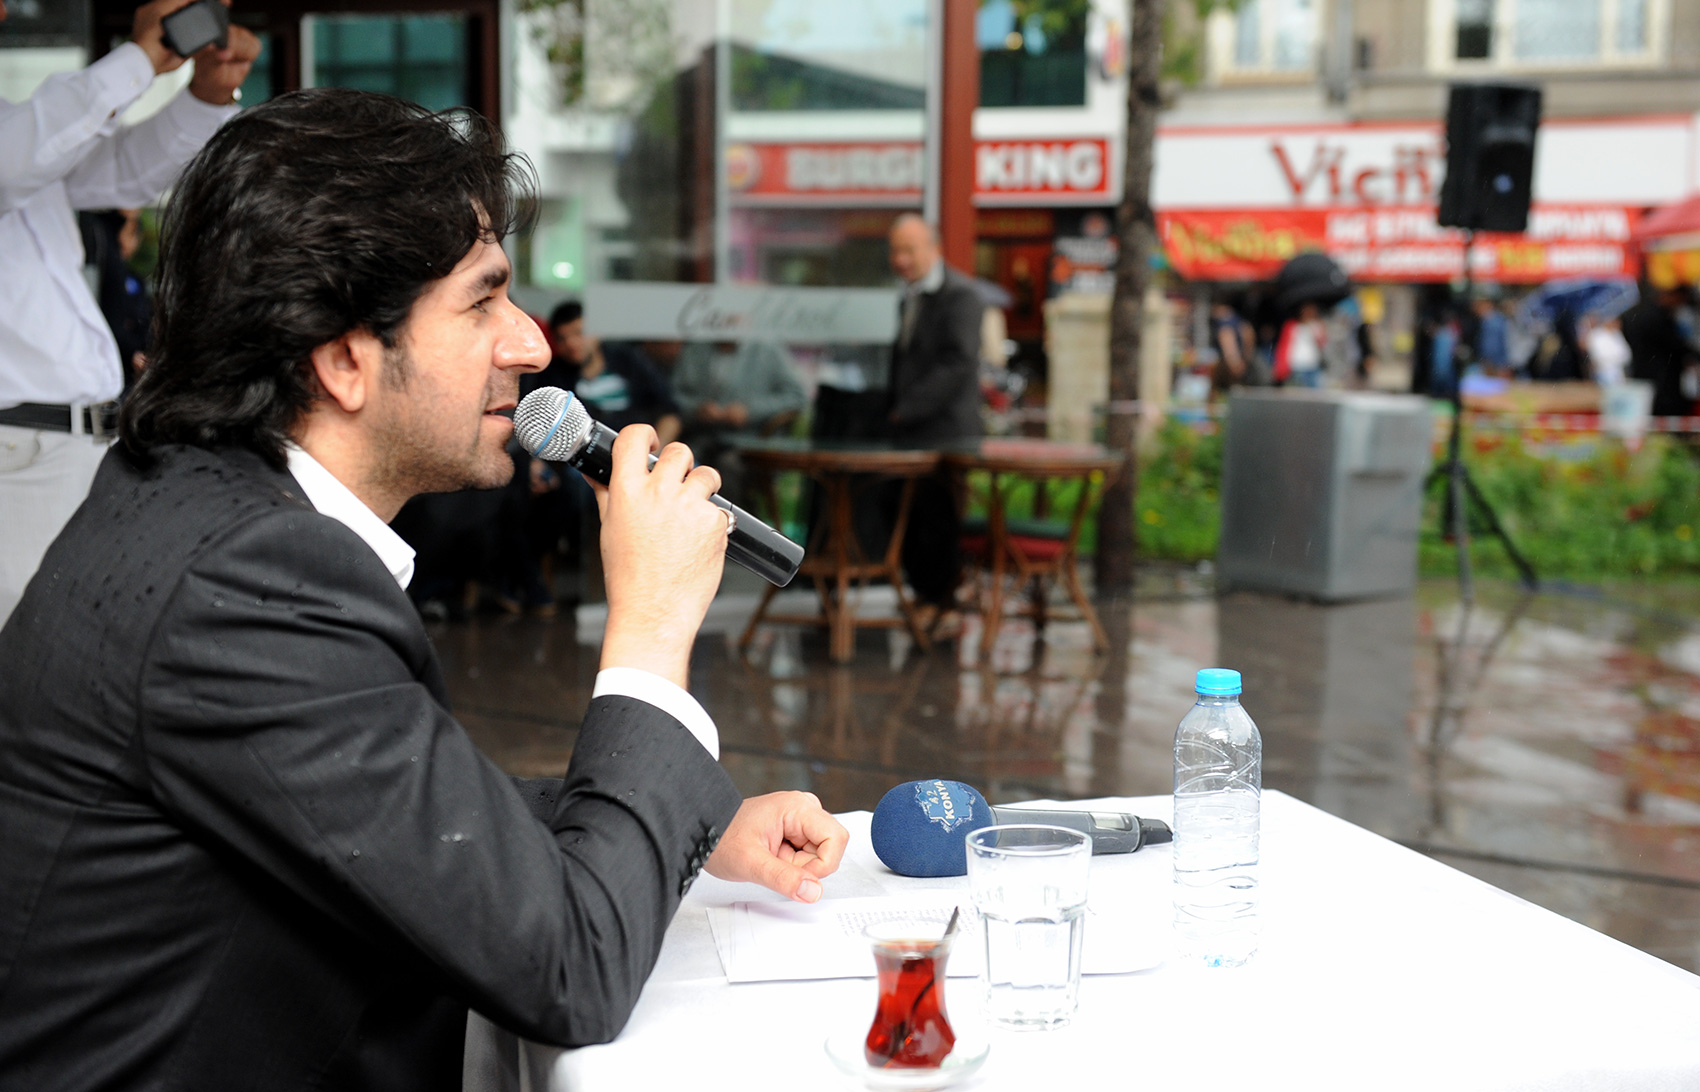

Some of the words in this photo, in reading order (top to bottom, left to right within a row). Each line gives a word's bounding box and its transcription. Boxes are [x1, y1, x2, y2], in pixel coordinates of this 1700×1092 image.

[786, 147, 924, 189] BURG
[976, 142, 1103, 191] KING
[926, 790, 939, 805] 42
[934, 780, 956, 819] KONYA
